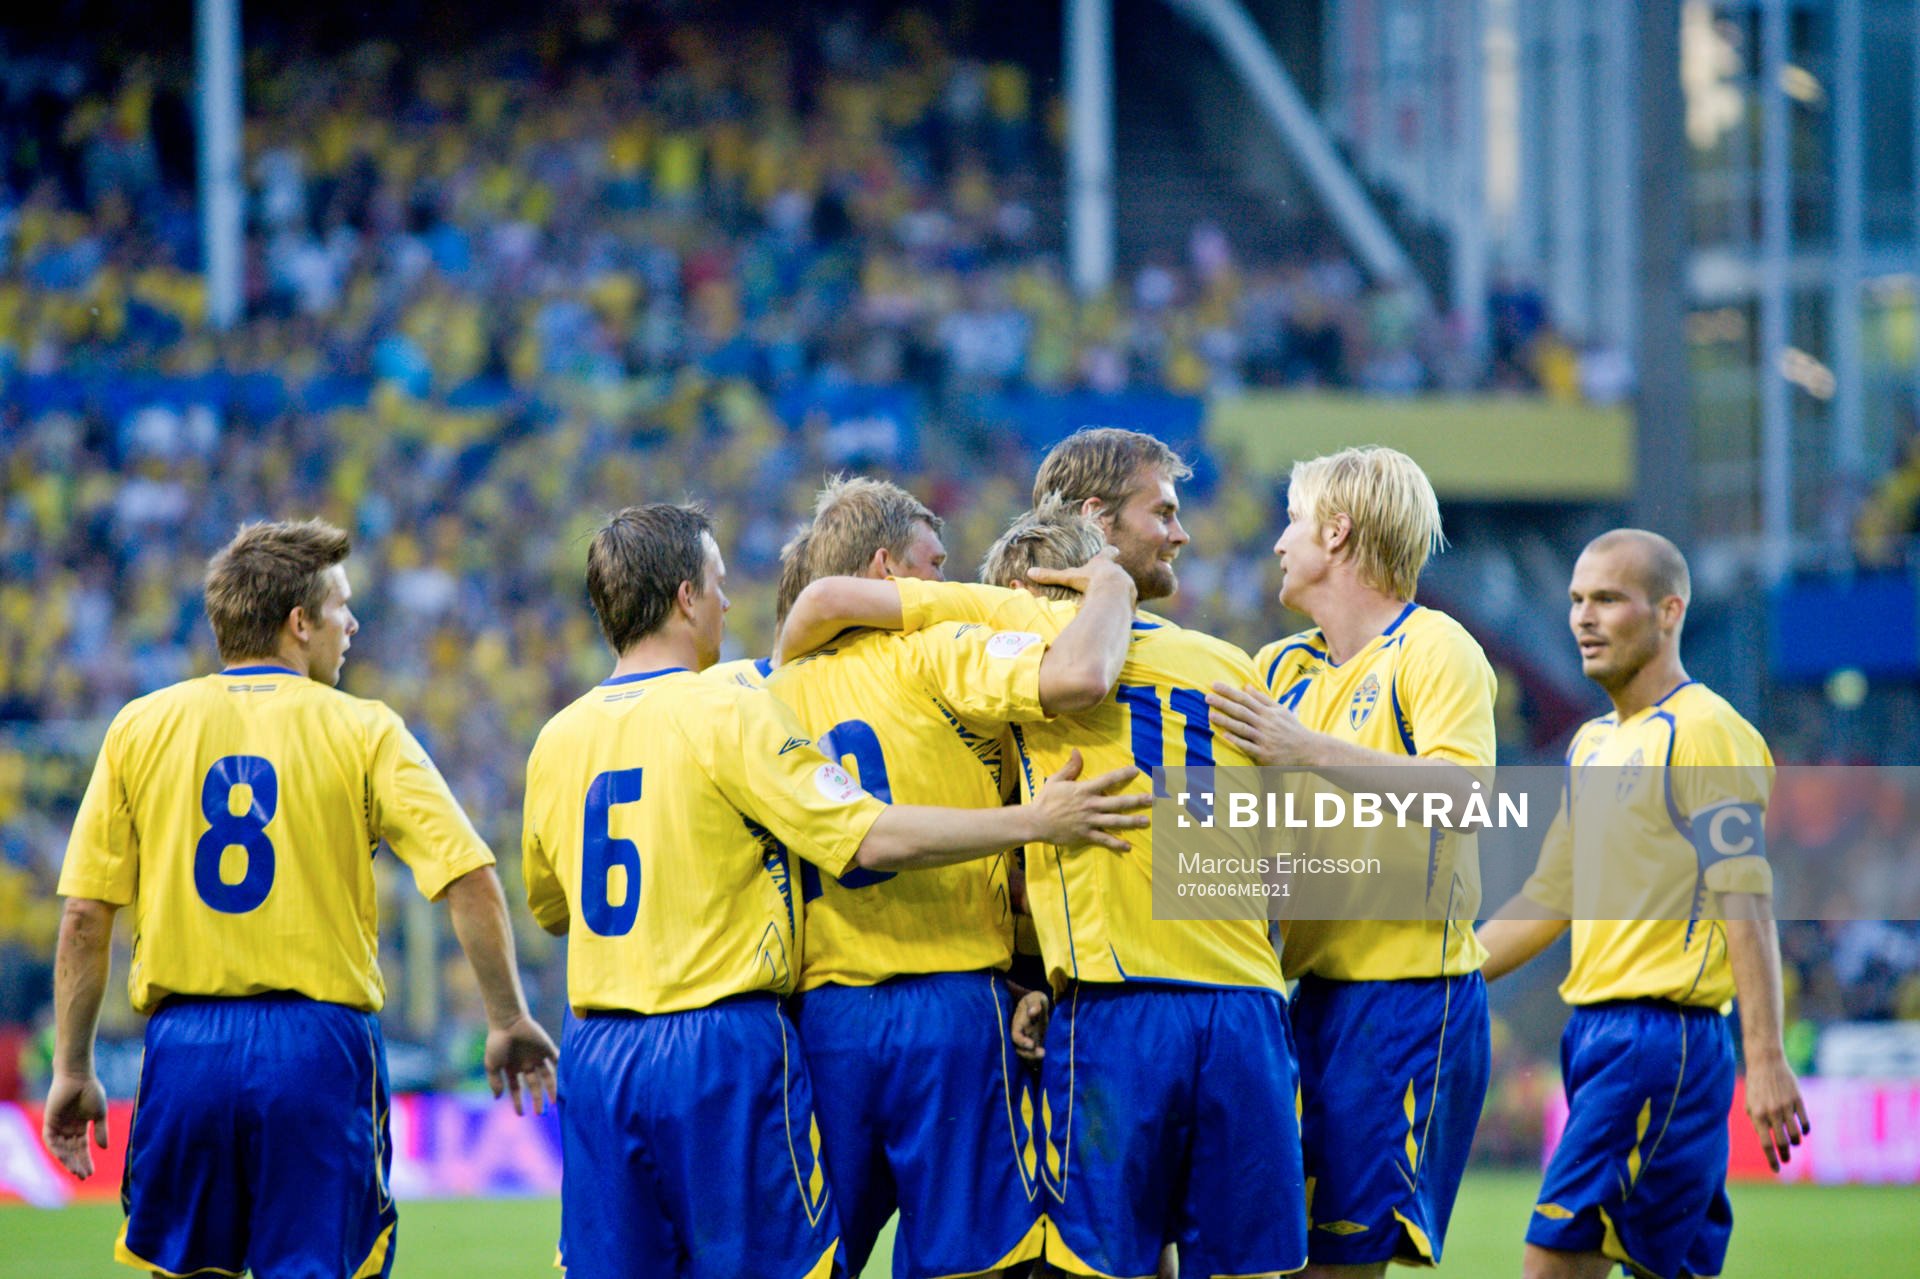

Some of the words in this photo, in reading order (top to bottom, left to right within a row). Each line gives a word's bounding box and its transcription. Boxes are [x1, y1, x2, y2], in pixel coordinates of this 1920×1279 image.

[1115, 683, 1217, 828] 11
[1708, 806, 1755, 856] C
[194, 754, 279, 915] 8
[581, 766, 644, 937] 6
